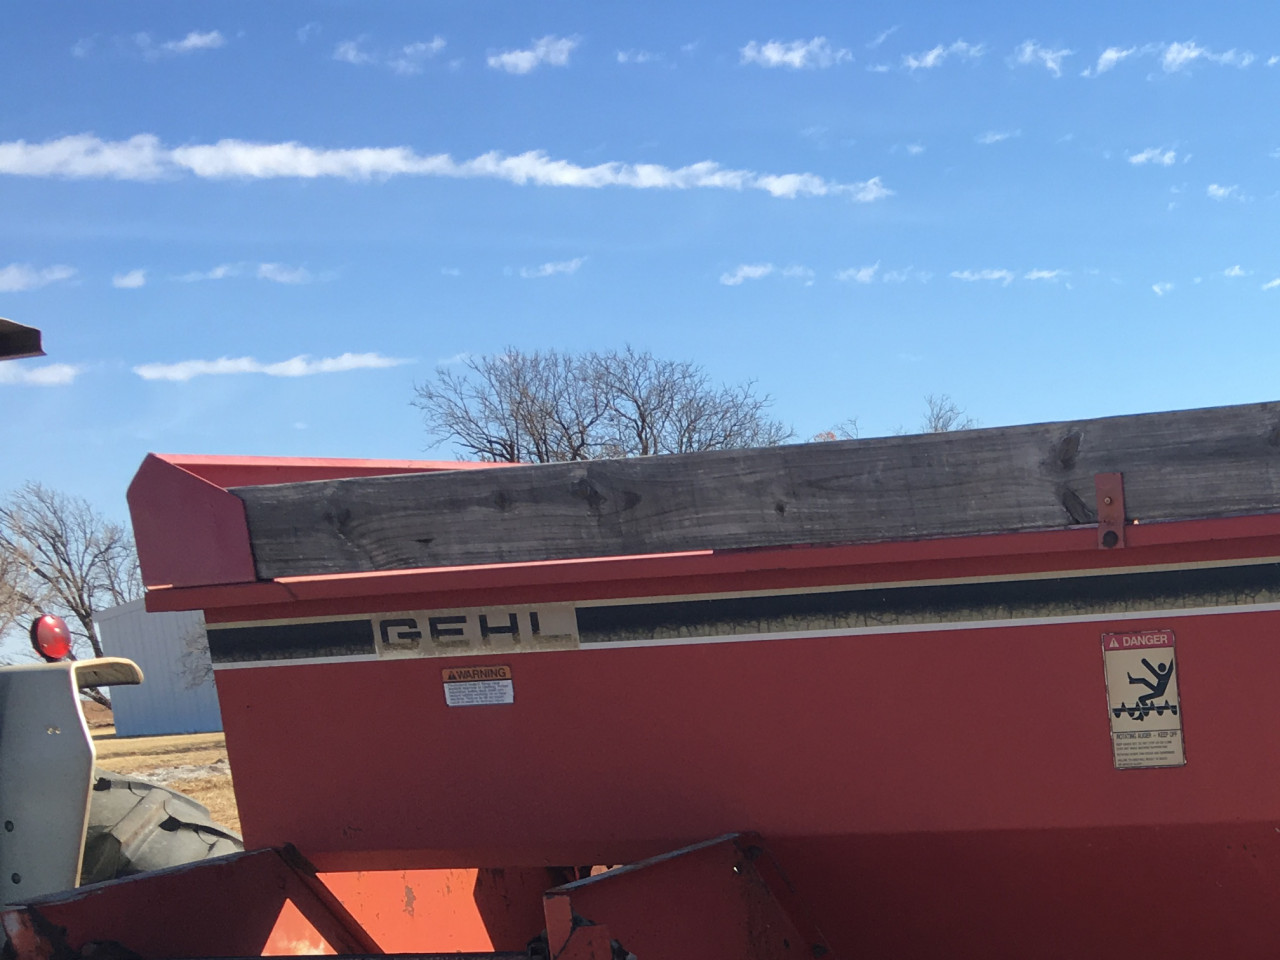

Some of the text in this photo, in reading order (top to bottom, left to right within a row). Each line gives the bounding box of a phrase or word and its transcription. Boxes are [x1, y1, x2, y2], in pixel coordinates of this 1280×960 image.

[379, 611, 573, 650] GEHL
[1123, 635, 1168, 647] DANGER
[457, 667, 507, 680] WARNING
